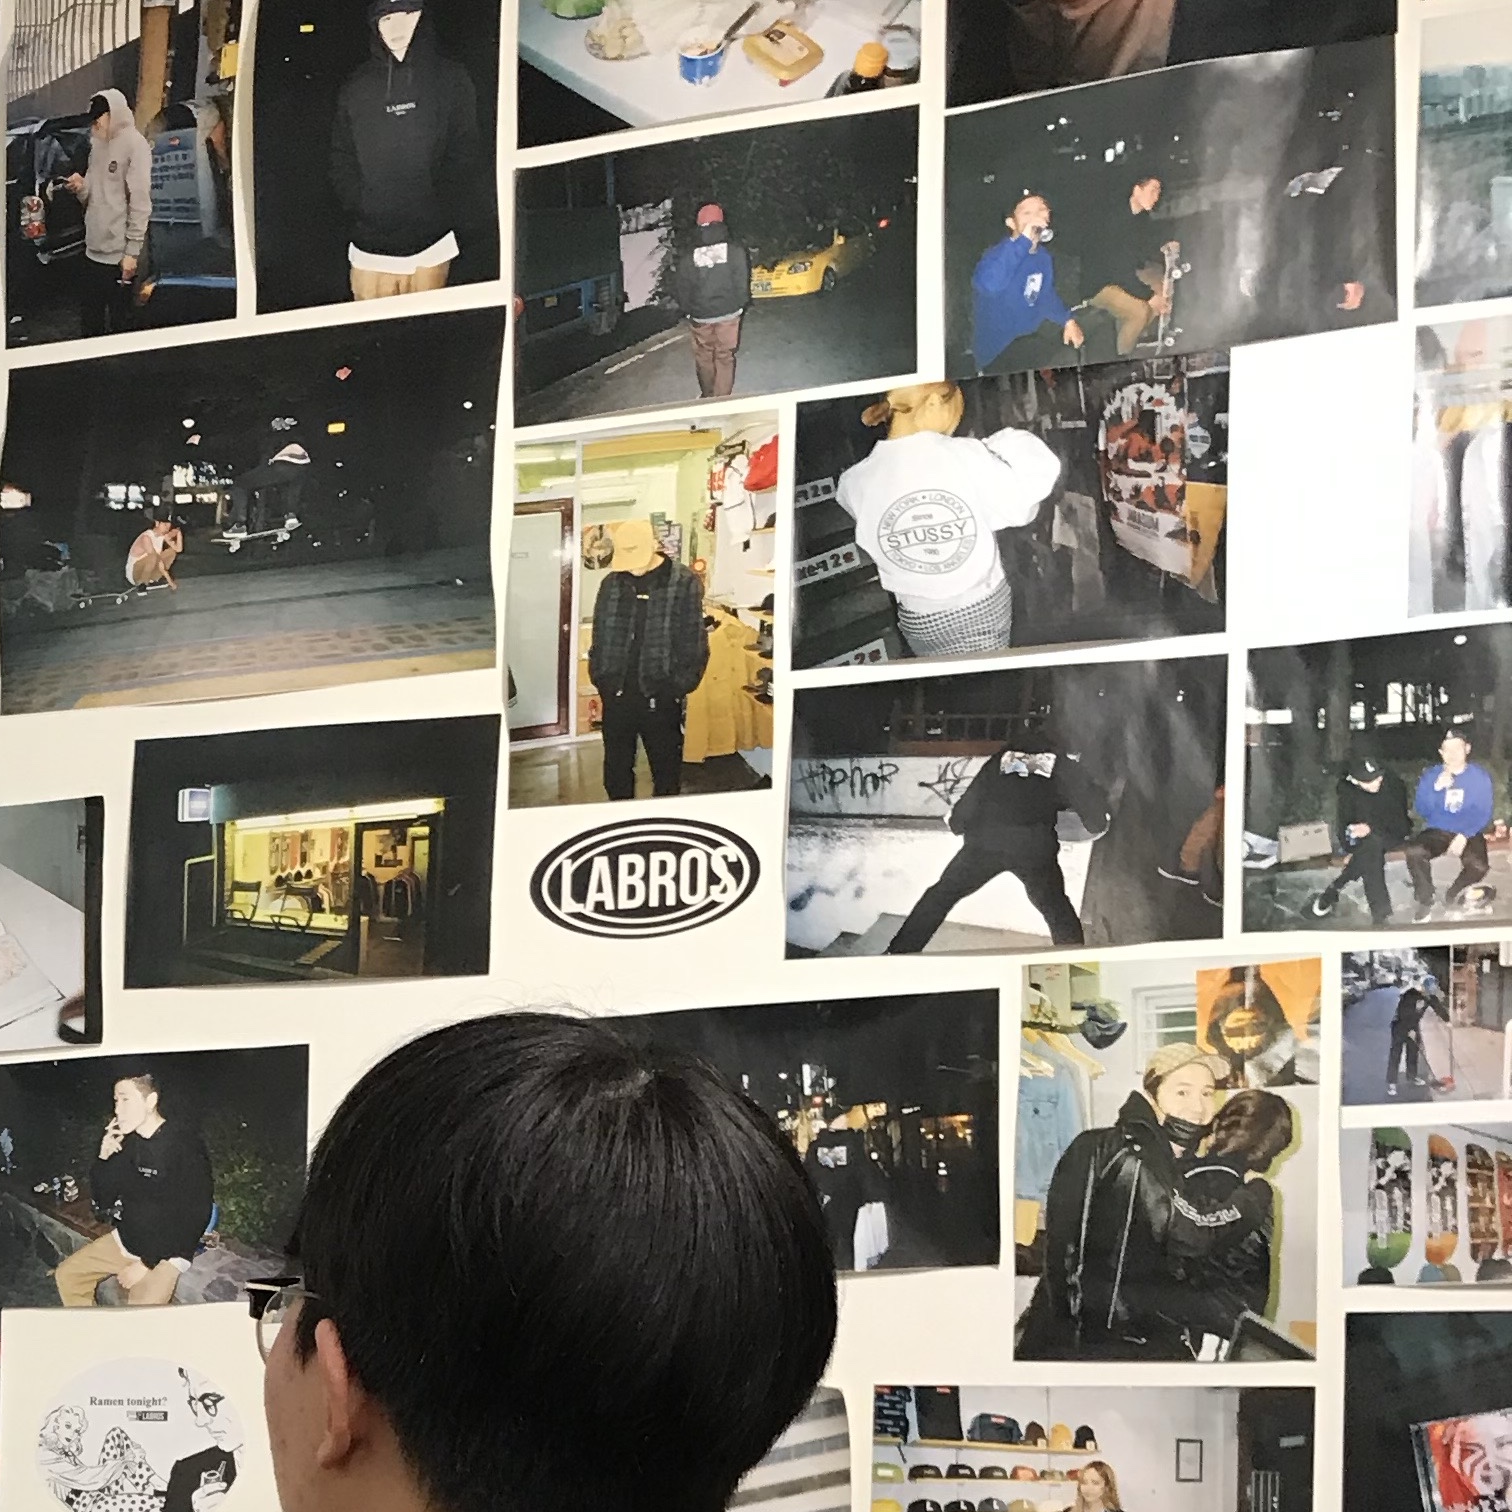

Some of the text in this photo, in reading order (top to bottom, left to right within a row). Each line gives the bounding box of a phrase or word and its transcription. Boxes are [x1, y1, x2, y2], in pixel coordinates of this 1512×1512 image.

[887, 520, 968, 549] STUSSY
[561, 846, 740, 913] LABROS
[89, 1396, 168, 1409] Ramen tonight?
